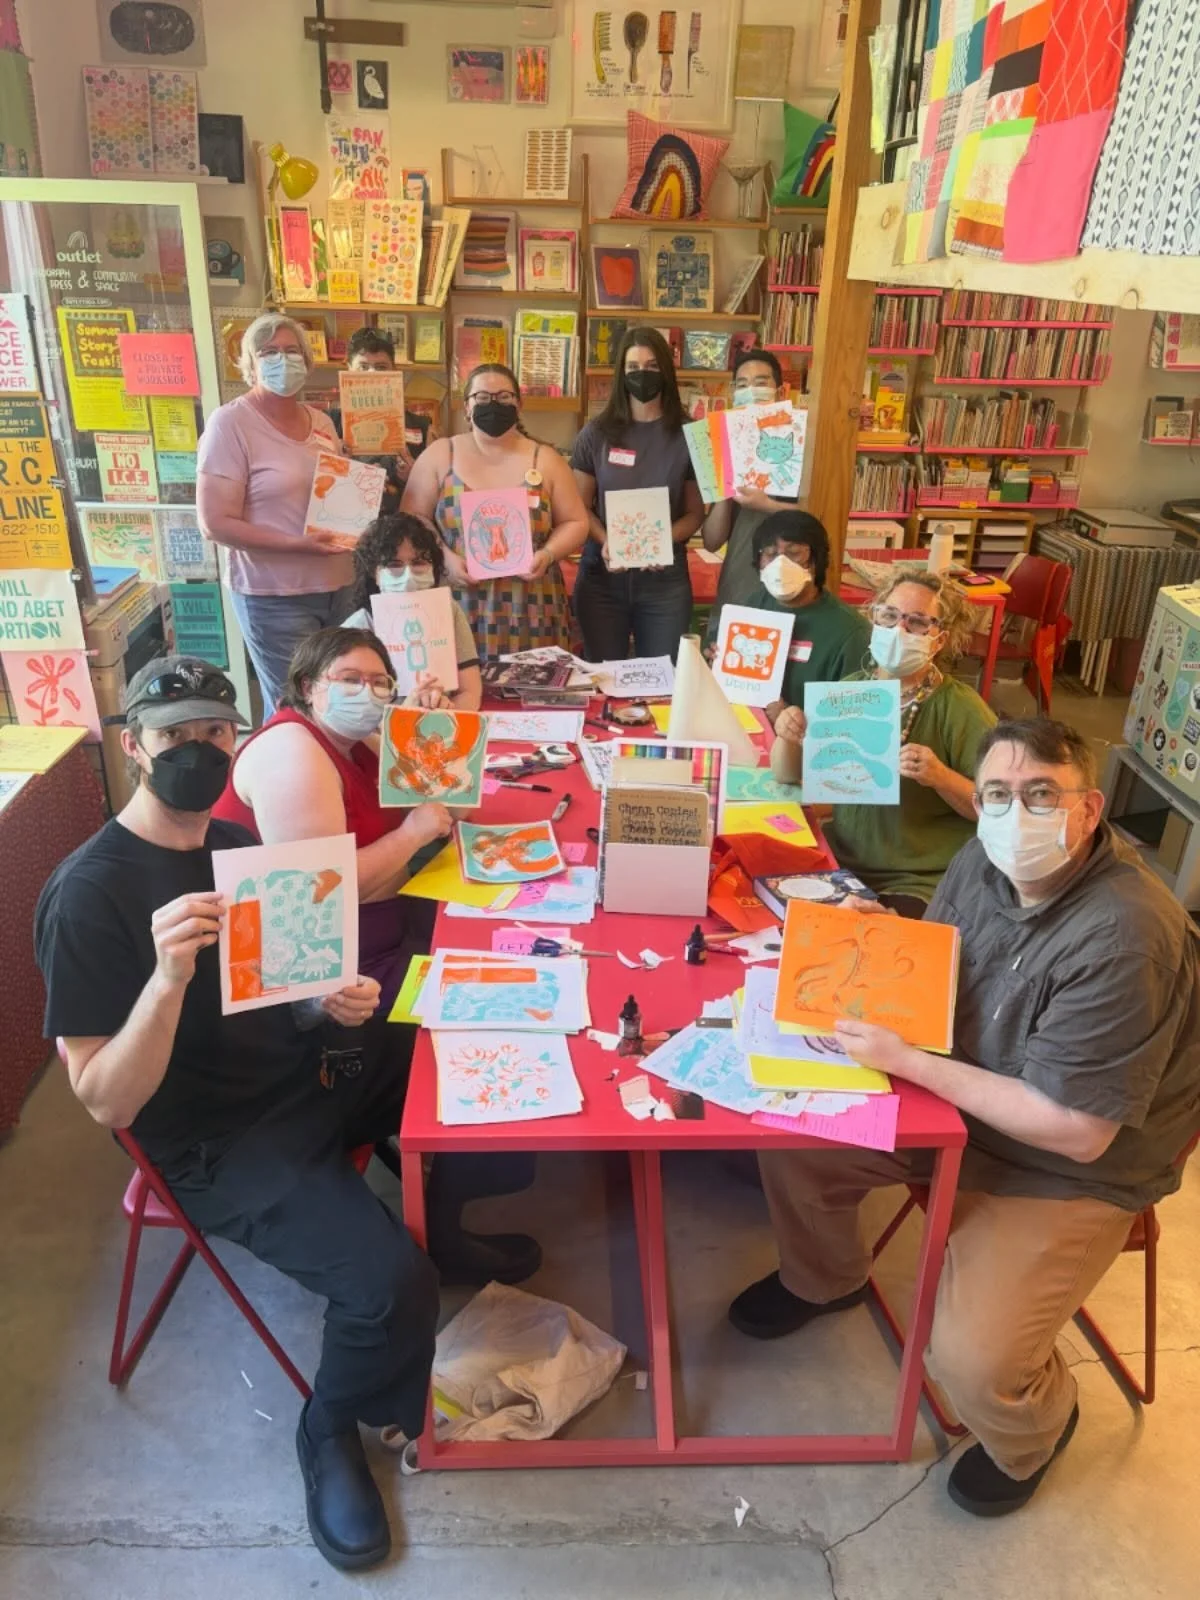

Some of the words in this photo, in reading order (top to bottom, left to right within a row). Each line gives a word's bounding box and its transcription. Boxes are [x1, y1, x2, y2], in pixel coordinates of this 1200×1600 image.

[56, 249, 103, 263] outlet
[49, 279, 73, 290] PRESS
[95, 281, 121, 292] SPACE
[78, 269, 90, 289] &
[75, 323, 121, 337] Summer
[132, 353, 169, 363] CLOSED
[146, 365, 184, 374] PRIVATE
[137, 375, 187, 385] WORKSHOP
[18, 441, 42, 453] THE
[115, 453, 137, 468] NO
[112, 470, 148, 485] I.C.E.
[88, 512, 108, 524] FREE
[110, 512, 150, 525] PALESTINE
[2, 523, 61, 536] 622-1510
[23, 600, 65, 618] ABET
[182, 599, 217, 614] WILL
[618, 803, 655, 817] Cheap
[657, 806, 698, 817] Copies!
[622, 823, 657, 836] Cheap
